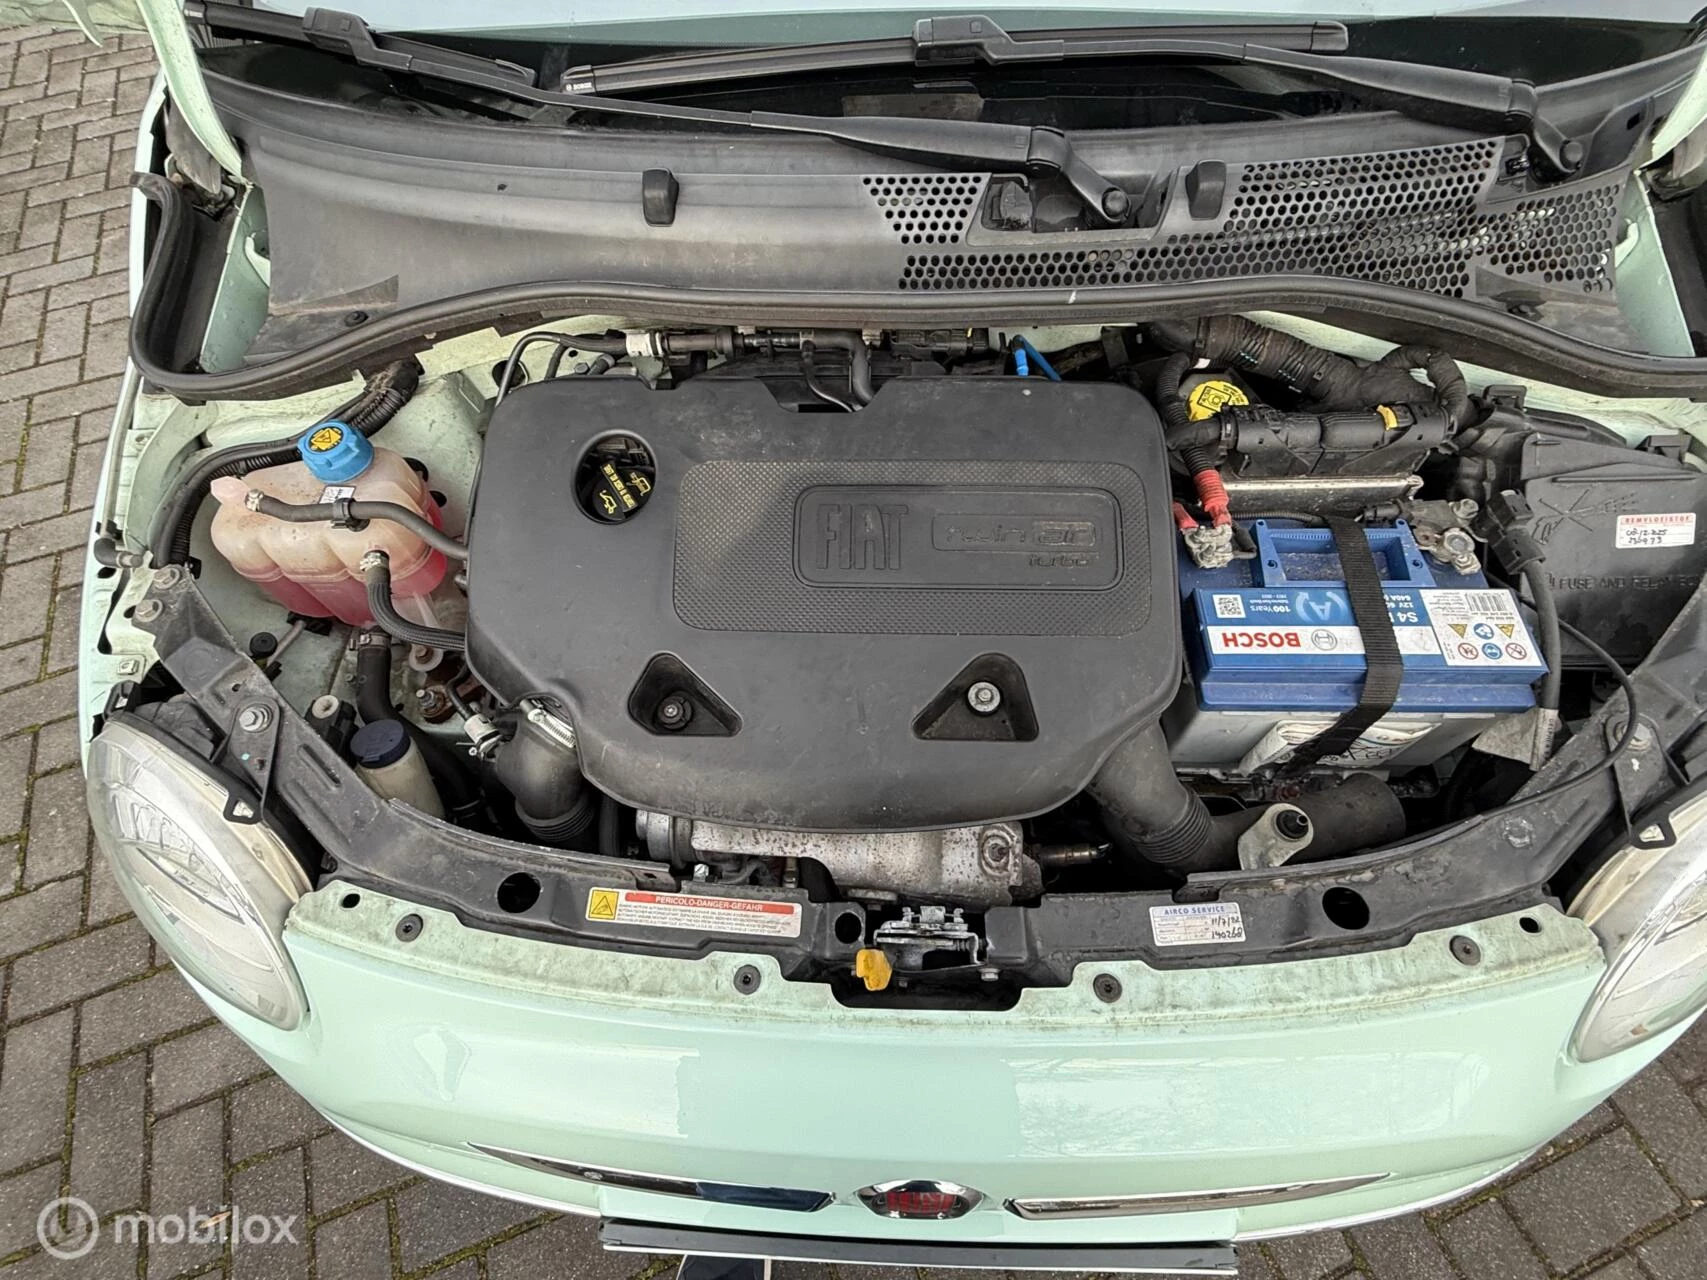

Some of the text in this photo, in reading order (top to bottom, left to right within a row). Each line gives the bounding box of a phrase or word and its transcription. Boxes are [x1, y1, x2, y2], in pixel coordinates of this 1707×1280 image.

[815, 504, 909, 570] FIAT
[1559, 576, 1594, 590] FUSE
[1249, 605, 1291, 613] 100 Years
[1396, 611, 1419, 623] S4
[1221, 632, 1302, 648] BOSCH
[655, 895, 764, 911] PERICOLO-DANGER-GEFAHR
[1164, 905, 1225, 915] AIRCO SERVICE
